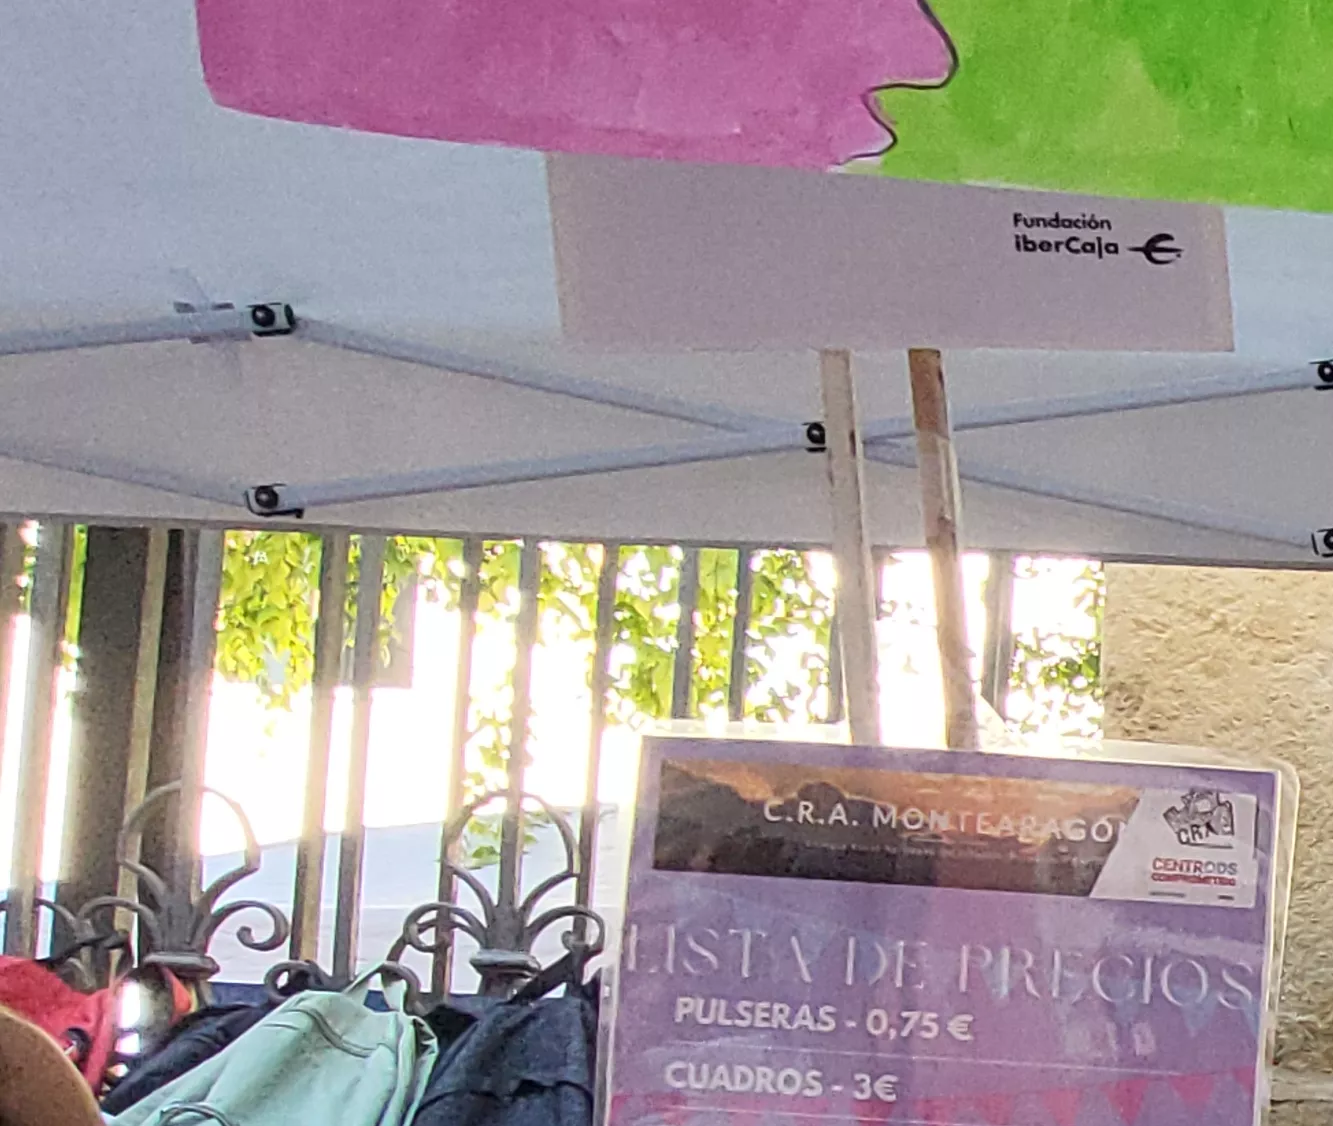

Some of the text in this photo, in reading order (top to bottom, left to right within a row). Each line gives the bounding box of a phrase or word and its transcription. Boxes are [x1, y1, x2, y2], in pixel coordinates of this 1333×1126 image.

[1013, 211, 1112, 231] Fundación
[762, 801, 859, 827] C.R.A.
[845, 935, 928, 988] DE
[959, 944, 1255, 1011] PRECIOS
[674, 996, 837, 1034] PULSERAS
[866, 1008, 940, 1040] 0,75
[946, 1012, 975, 1041] €
[664, 1061, 823, 1098] CUADROS
[852, 1072, 899, 1102] 3€
